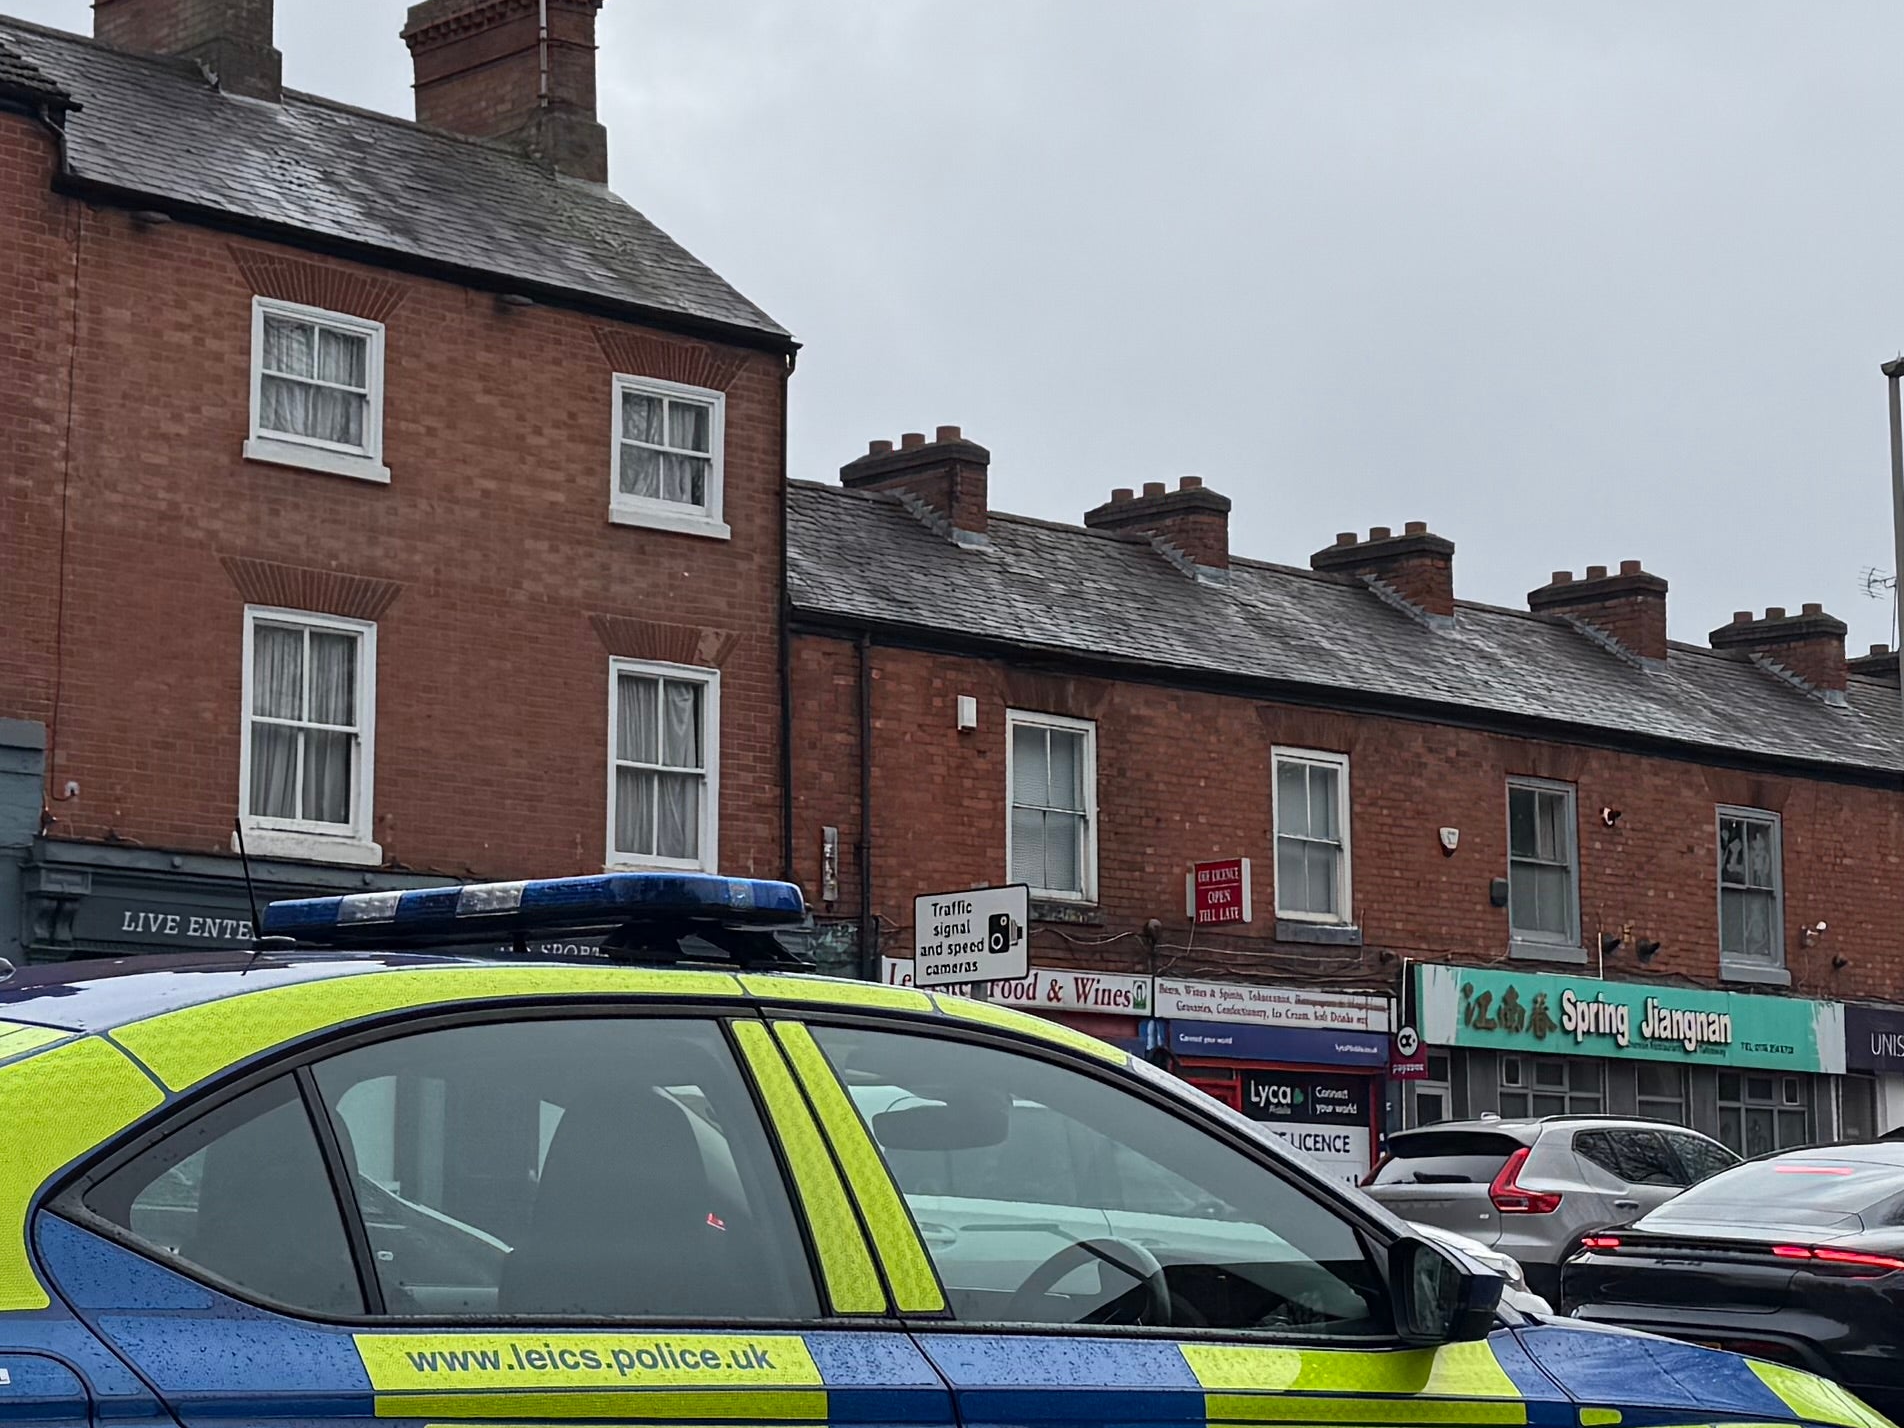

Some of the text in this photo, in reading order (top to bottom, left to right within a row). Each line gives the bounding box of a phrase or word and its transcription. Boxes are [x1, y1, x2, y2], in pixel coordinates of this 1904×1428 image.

[1208, 889, 1231, 904] OPEN
[931, 900, 972, 917] Traffic
[1199, 907, 1239, 922] TILL LATE
[122, 911, 180, 934] LIVE
[933, 919, 970, 938] signal
[920, 937, 984, 956] and speed
[926, 960, 978, 976] cameras
[1047, 979, 1063, 1002] &
[1073, 976, 1132, 1008] Wines
[1562, 989, 1733, 1052] Spring Jiangnan
[1250, 1079, 1348, 1107] Lyca Connect
[1315, 1104, 1334, 1115] your
[1335, 1103, 1357, 1115] world
[1291, 1133, 1350, 1153] LICENCE
[406, 1343, 776, 1376] www.leics.police.uk
